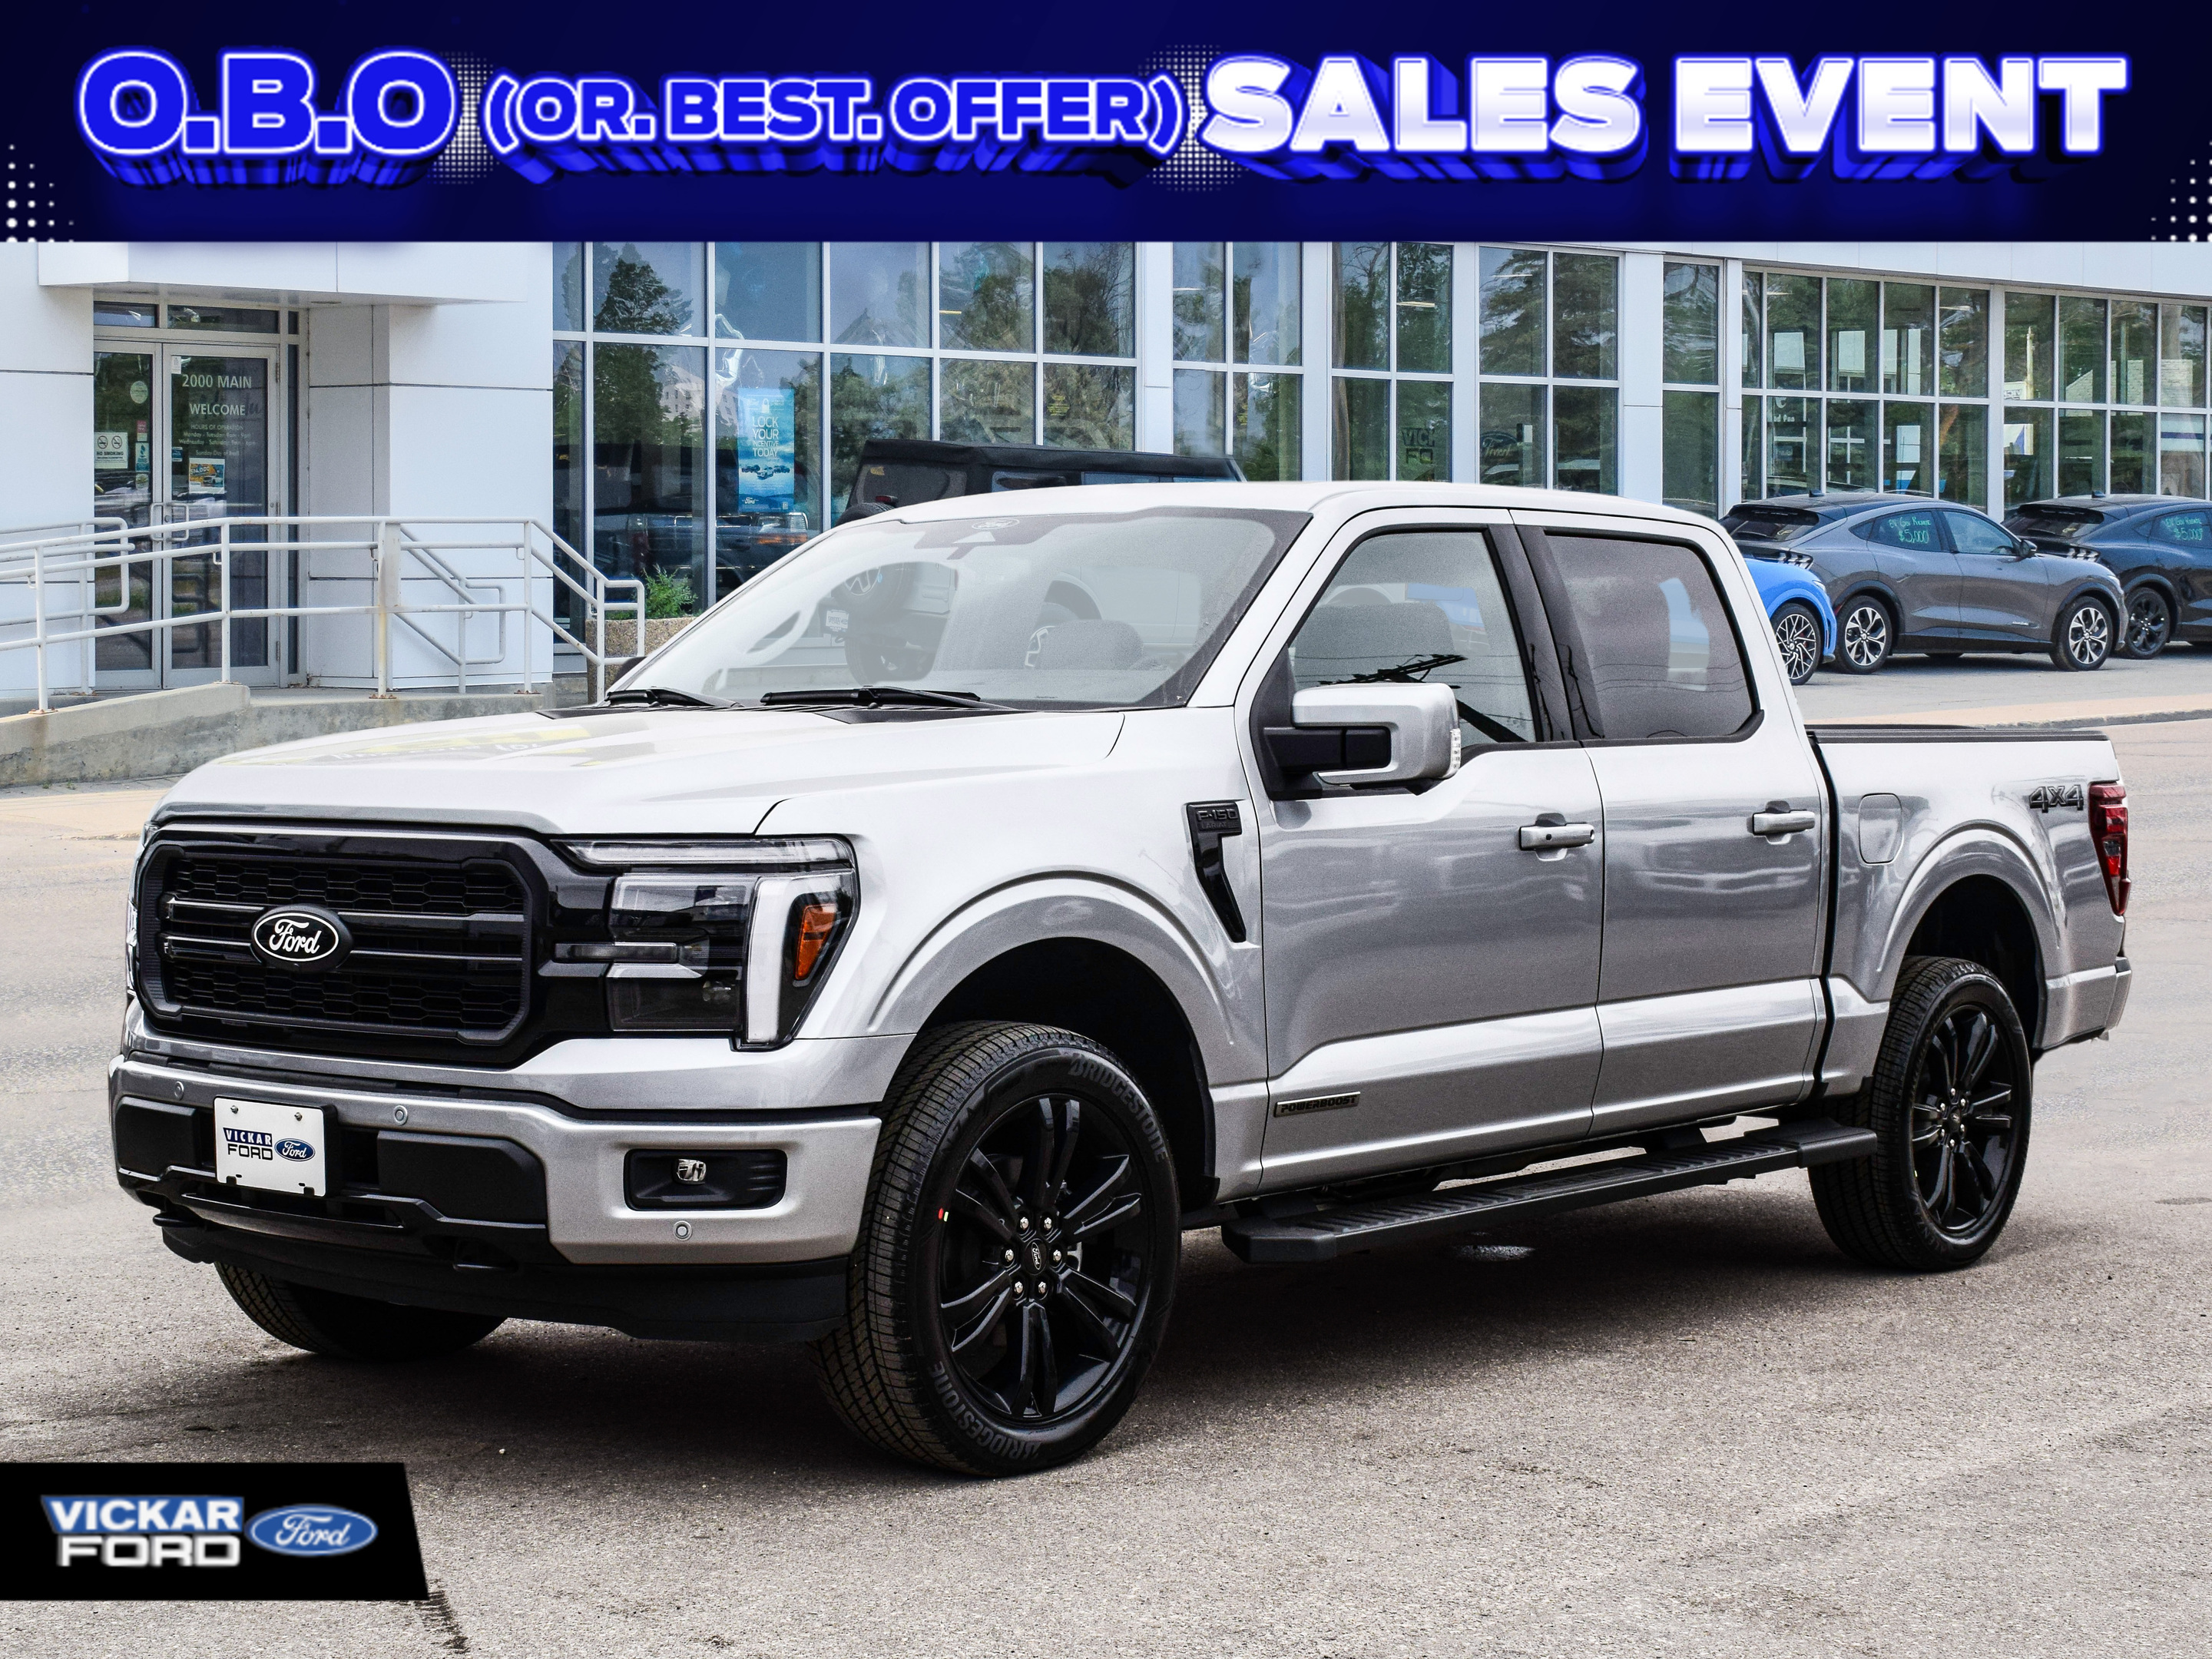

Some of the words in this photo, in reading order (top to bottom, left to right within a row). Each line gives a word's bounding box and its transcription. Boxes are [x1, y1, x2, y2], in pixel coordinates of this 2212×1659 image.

[182, 374, 214, 388] 2000
[217, 375, 252, 389] MAIN
[189, 403, 246, 416] WELCOME
[752, 416, 779, 428] LOCK
[752, 429, 780, 439] YOUR
[753, 448, 779, 457] TODAY
[1197, 808, 1239, 821] F-150
[269, 919, 322, 954] Ford
[1068, 1052, 1166, 1164] BRIDGESTONE
[1280, 1094, 1358, 1113] POWERBOOST
[226, 1129, 273, 1146] VICKAR
[227, 1144, 273, 1161] FORD
[282, 1141, 307, 1158] Ford
[929, 1360, 1042, 1459] BRIDGESTONE
